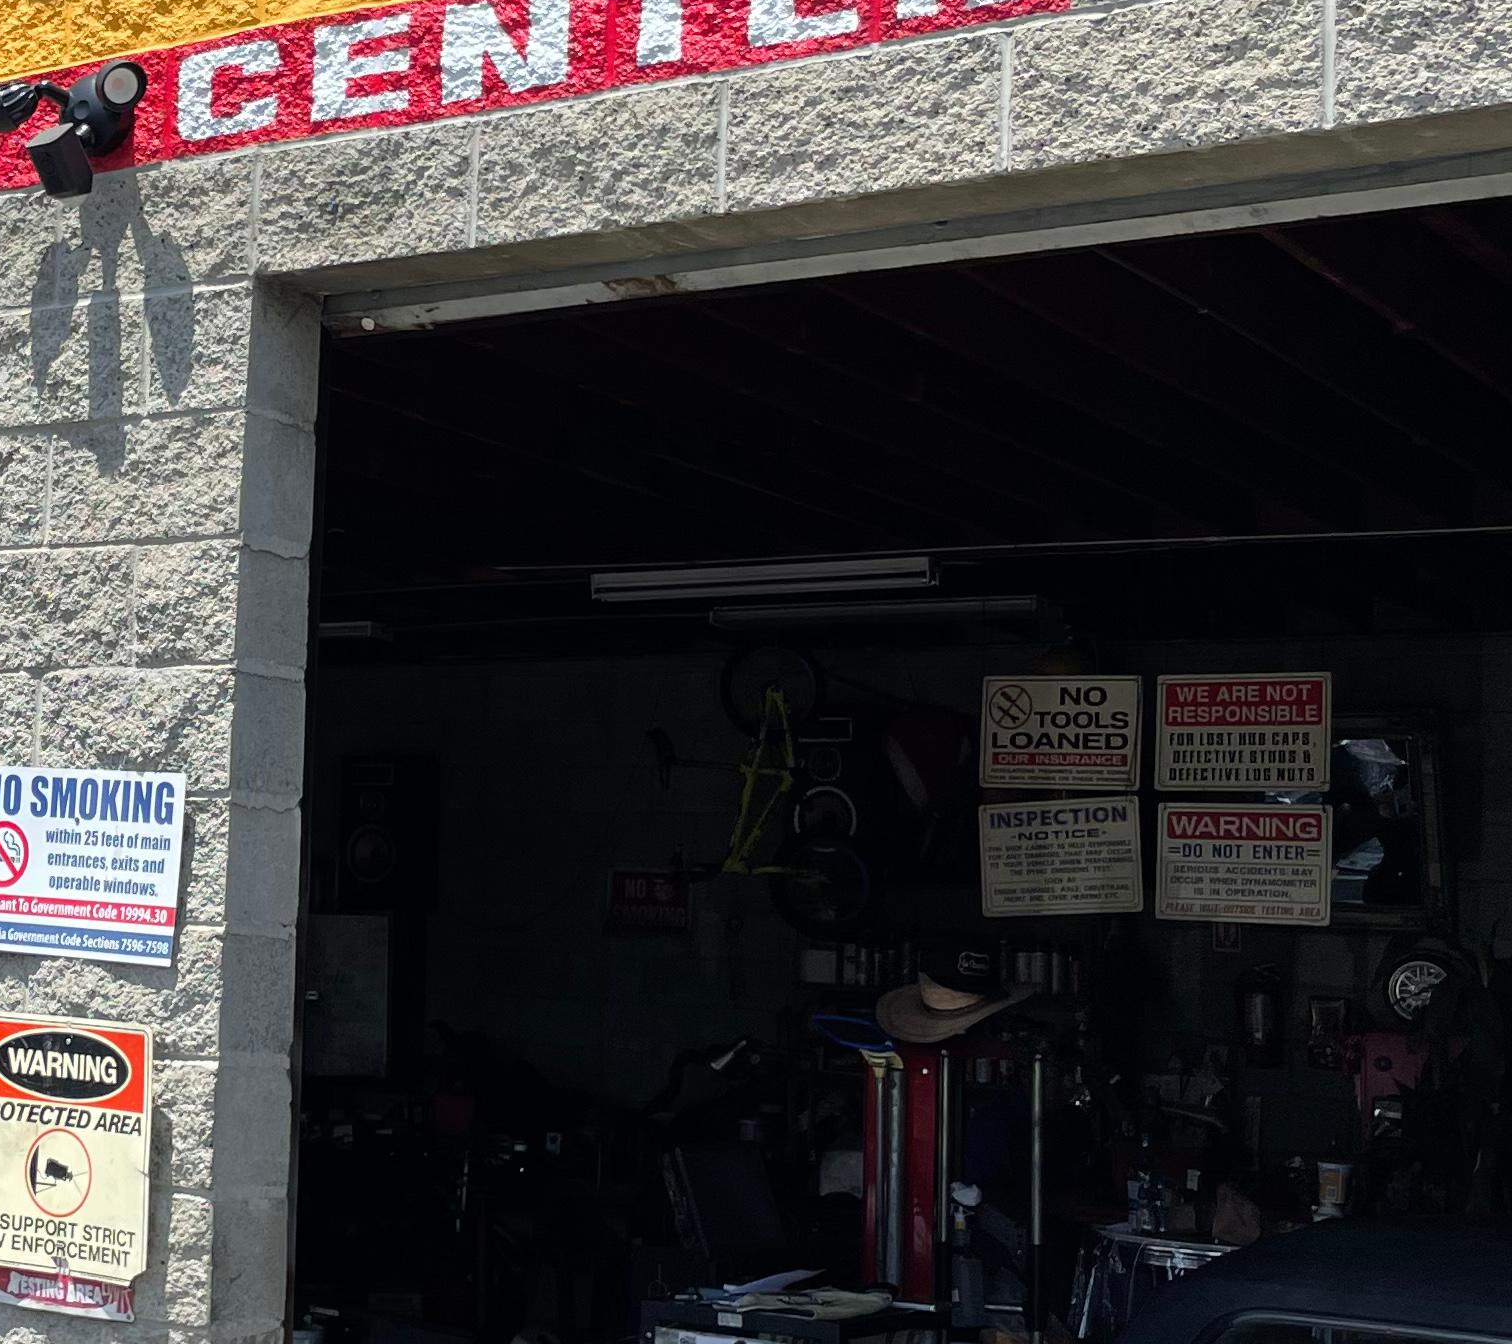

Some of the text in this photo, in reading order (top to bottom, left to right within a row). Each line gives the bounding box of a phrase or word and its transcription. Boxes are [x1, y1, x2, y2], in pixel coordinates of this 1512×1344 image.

[1060, 686, 1107, 706] NO
[1176, 684, 1312, 703] WE ARE NOT
[1034, 711, 1129, 729] TOOLS
[1168, 705, 1319, 723] RESPONSIBLE
[992, 732, 1128, 750] LOANED
[1170, 732, 1194, 746] FOR
[1199, 732, 1233, 746] LOST
[998, 753, 1122, 767] OUR INSURANCE
[1173, 750, 1243, 764] DEFECTIVE
[1169, 768, 1239, 781] DEFECTIVE
[1277, 768, 1314, 781] NUTS
[30, 775, 175, 825] SMOKING
[990, 806, 1127, 829] INSPECTION
[1170, 815, 1319, 838] WARNING
[45, 828, 171, 851] within 25 feet of main
[1212, 844, 1243, 859] NOT
[47, 852, 165, 874] entrances, exits and
[1225, 866, 1286, 876] ACCIDENTS
[1291, 868, 1314, 877] MAY
[48, 875, 159, 898] operable windows.
[1170, 876, 1204, 885] OCCUR
[1209, 877, 1239, 886] WHEN
[18, 899, 29, 912] To
[30, 900, 90, 918] Government
[92, 904, 117, 920] Code
[120, 906, 168, 924] 19994.30
[7, 928, 59, 946] Government
[60, 932, 81, 947] Code
[82, 934, 119, 951] Sections
[121, 937, 169, 956] 7596-7598
[7, 1046, 118, 1085] WARNING
[93, 1112, 143, 1136] AREA
[0, 1214, 78, 1240] SUPPORT
[82, 1223, 136, 1249] STRICT
[11, 1235, 131, 1268] ENFORCEMENT
[66, 1281, 103, 1305] AREA
